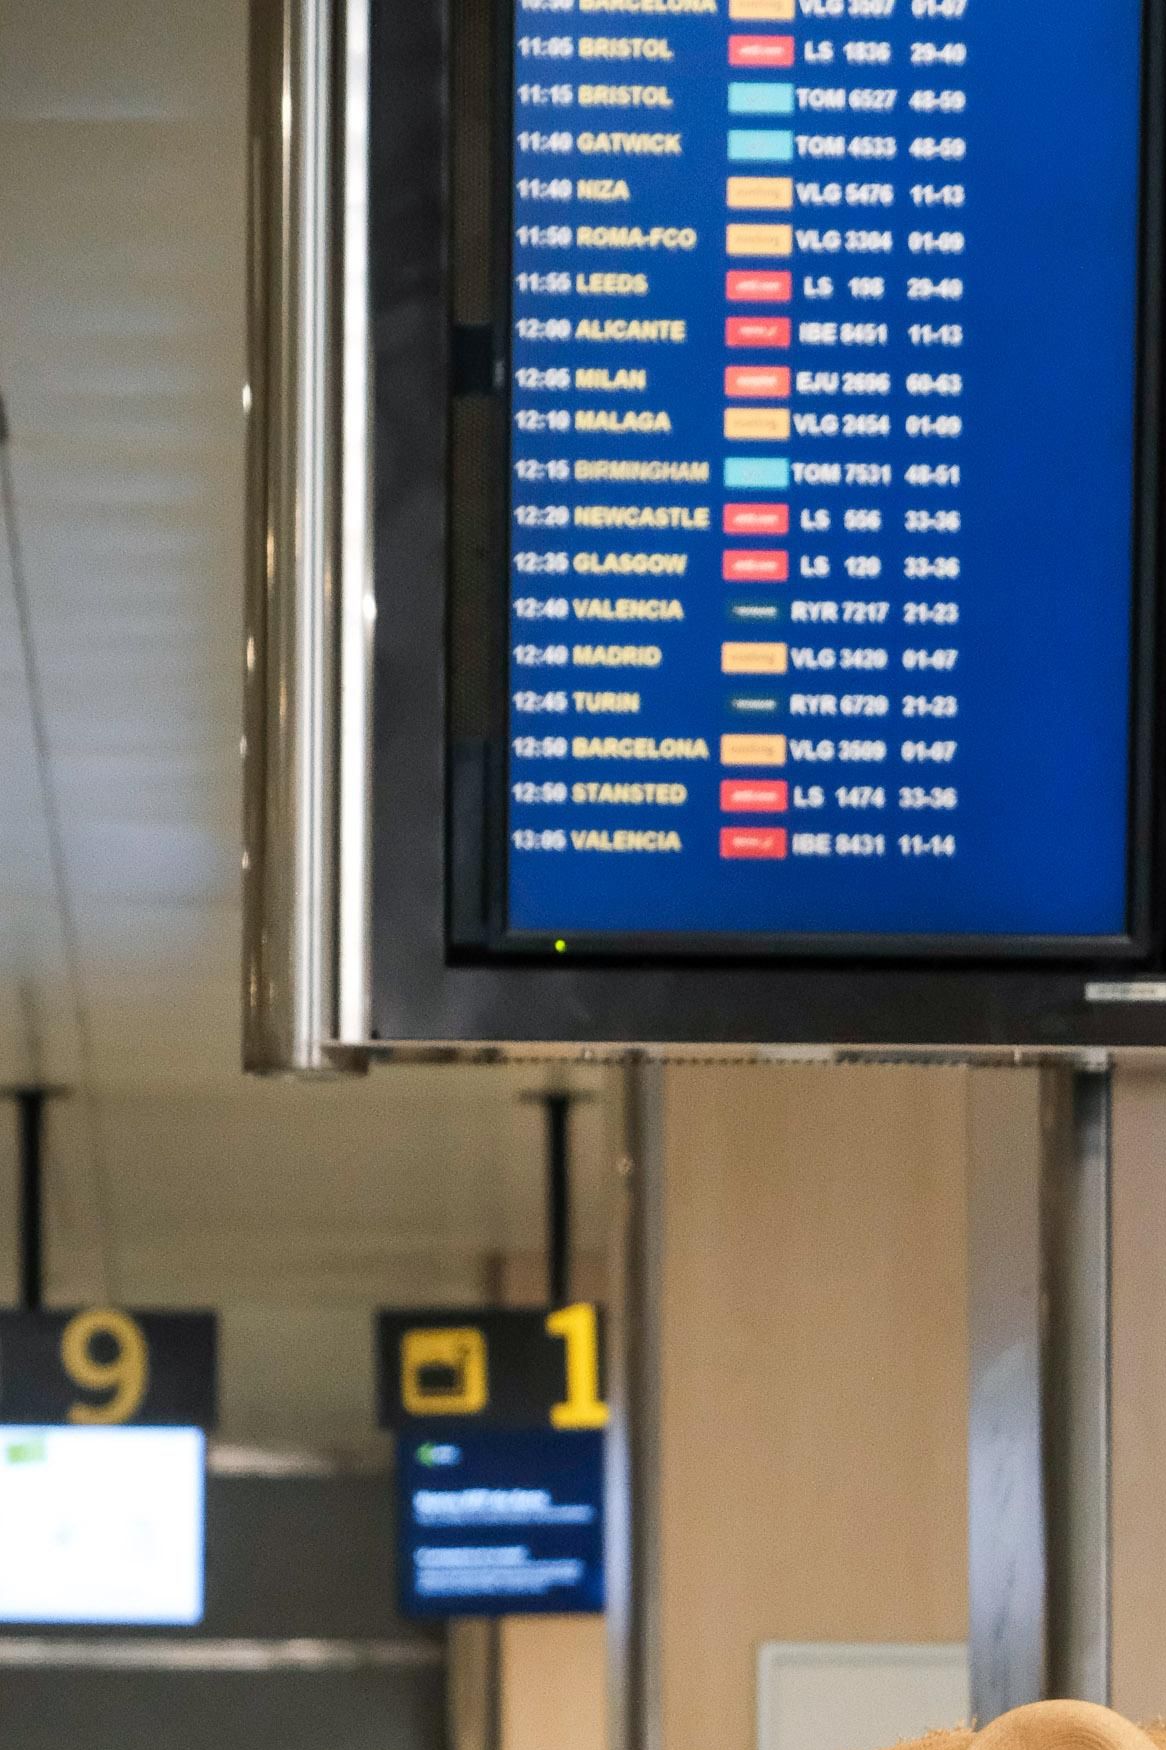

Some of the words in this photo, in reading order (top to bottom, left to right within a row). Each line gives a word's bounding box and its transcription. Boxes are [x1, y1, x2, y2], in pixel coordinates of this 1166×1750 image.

[578, 37, 673, 60] BRISTOL
[805, 41, 833, 61] LS
[578, 85, 672, 107] BRISTOL
[797, 88, 845, 108] TOM
[577, 132, 681, 154] GATWICK
[796, 136, 845, 156] TOM
[577, 180, 629, 201] NIZA
[796, 183, 842, 204] VLG
[577, 227, 696, 248] ROMA-FCO
[796, 230, 841, 250] VLG
[576, 273, 648, 294] LEEDS
[804, 277, 832, 296] LS
[575, 320, 685, 341] ALICANTE
[576, 369, 646, 390] MILAN
[575, 411, 671, 432] MALAGA
[794, 414, 838, 434] VLG
[575, 460, 709, 481] BIRMINGHAM
[792, 463, 841, 483] TOM
[574, 506, 709, 528] NEWCASTLE
[801, 510, 830, 529] LS
[573, 553, 687, 574] GLASGOW
[801, 556, 829, 576] LS
[573, 599, 683, 619] VALENCIA
[791, 601, 837, 621] RYR
[843, 602, 889, 622] 7217
[573, 646, 661, 666] MADRID
[791, 648, 835, 668] VLG
[573, 692, 639, 712] TURIN
[790, 694, 836, 714] RYR
[572, 737, 709, 758] BARCELONA
[790, 740, 834, 760] VLG
[573, 783, 687, 804] STANSTED
[794, 787, 824, 807] LS
[836, 787, 884, 806] 1474
[571, 831, 681, 850] VALENCIA
[900, 835, 954, 854] 11-14
[60, 1307, 149, 1424] 9
